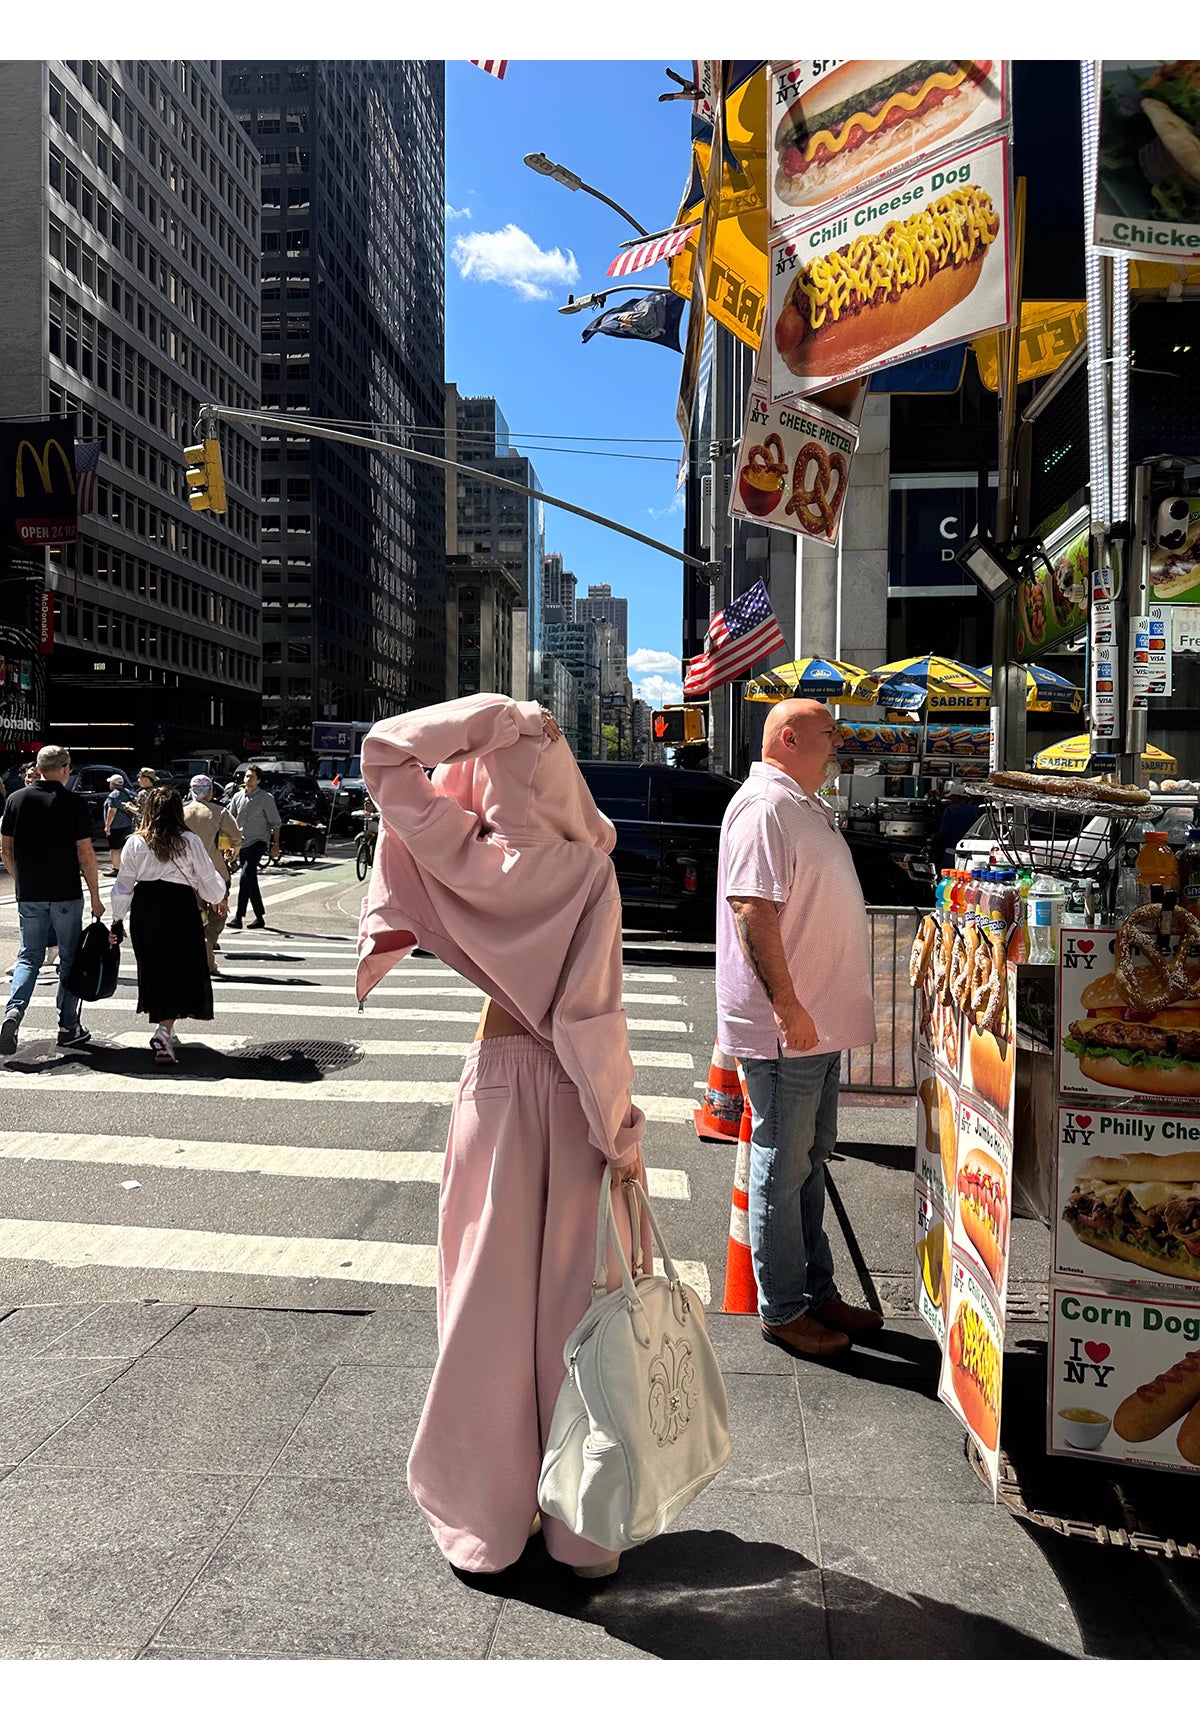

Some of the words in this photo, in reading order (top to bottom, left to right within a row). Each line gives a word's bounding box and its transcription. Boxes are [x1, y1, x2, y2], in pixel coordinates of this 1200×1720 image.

[779, 74, 787, 90] I
[776, 79, 804, 106] NY
[808, 217, 848, 248] Chili
[853, 184, 924, 227] Cheese
[931, 162, 972, 191] Dog
[778, 248, 785, 262] I
[775, 254, 799, 277] NY
[750, 411, 770, 426] NY
[779, 410, 818, 440] CHEESE
[818, 426, 852, 456] PRETZEL
[21, 526, 50, 539] OPEN
[52, 525, 63, 538] 24
[41, 593, 50, 643] McDonald's
[751, 685, 796, 695] SABRETT
[931, 696, 991, 707] SABRETT
[1040, 757, 1087, 768] SABRETT
[1141, 761, 1176, 772] SABRETT
[1067, 939, 1076, 953] I
[1063, 954, 1098, 969] NY
[1066, 1113, 1075, 1129] I
[975, 1117, 993, 1148] Jumbo
[1062, 1129, 1095, 1146] NY
[1100, 1117, 1155, 1142] Philly
[1162, 1122, 1200, 1141] Che
[1061, 1297, 1131, 1328] Corn
[1143, 1307, 1200, 1341] Dog
[1069, 1337, 1083, 1361] I
[1063, 1360, 1115, 1387] NY
